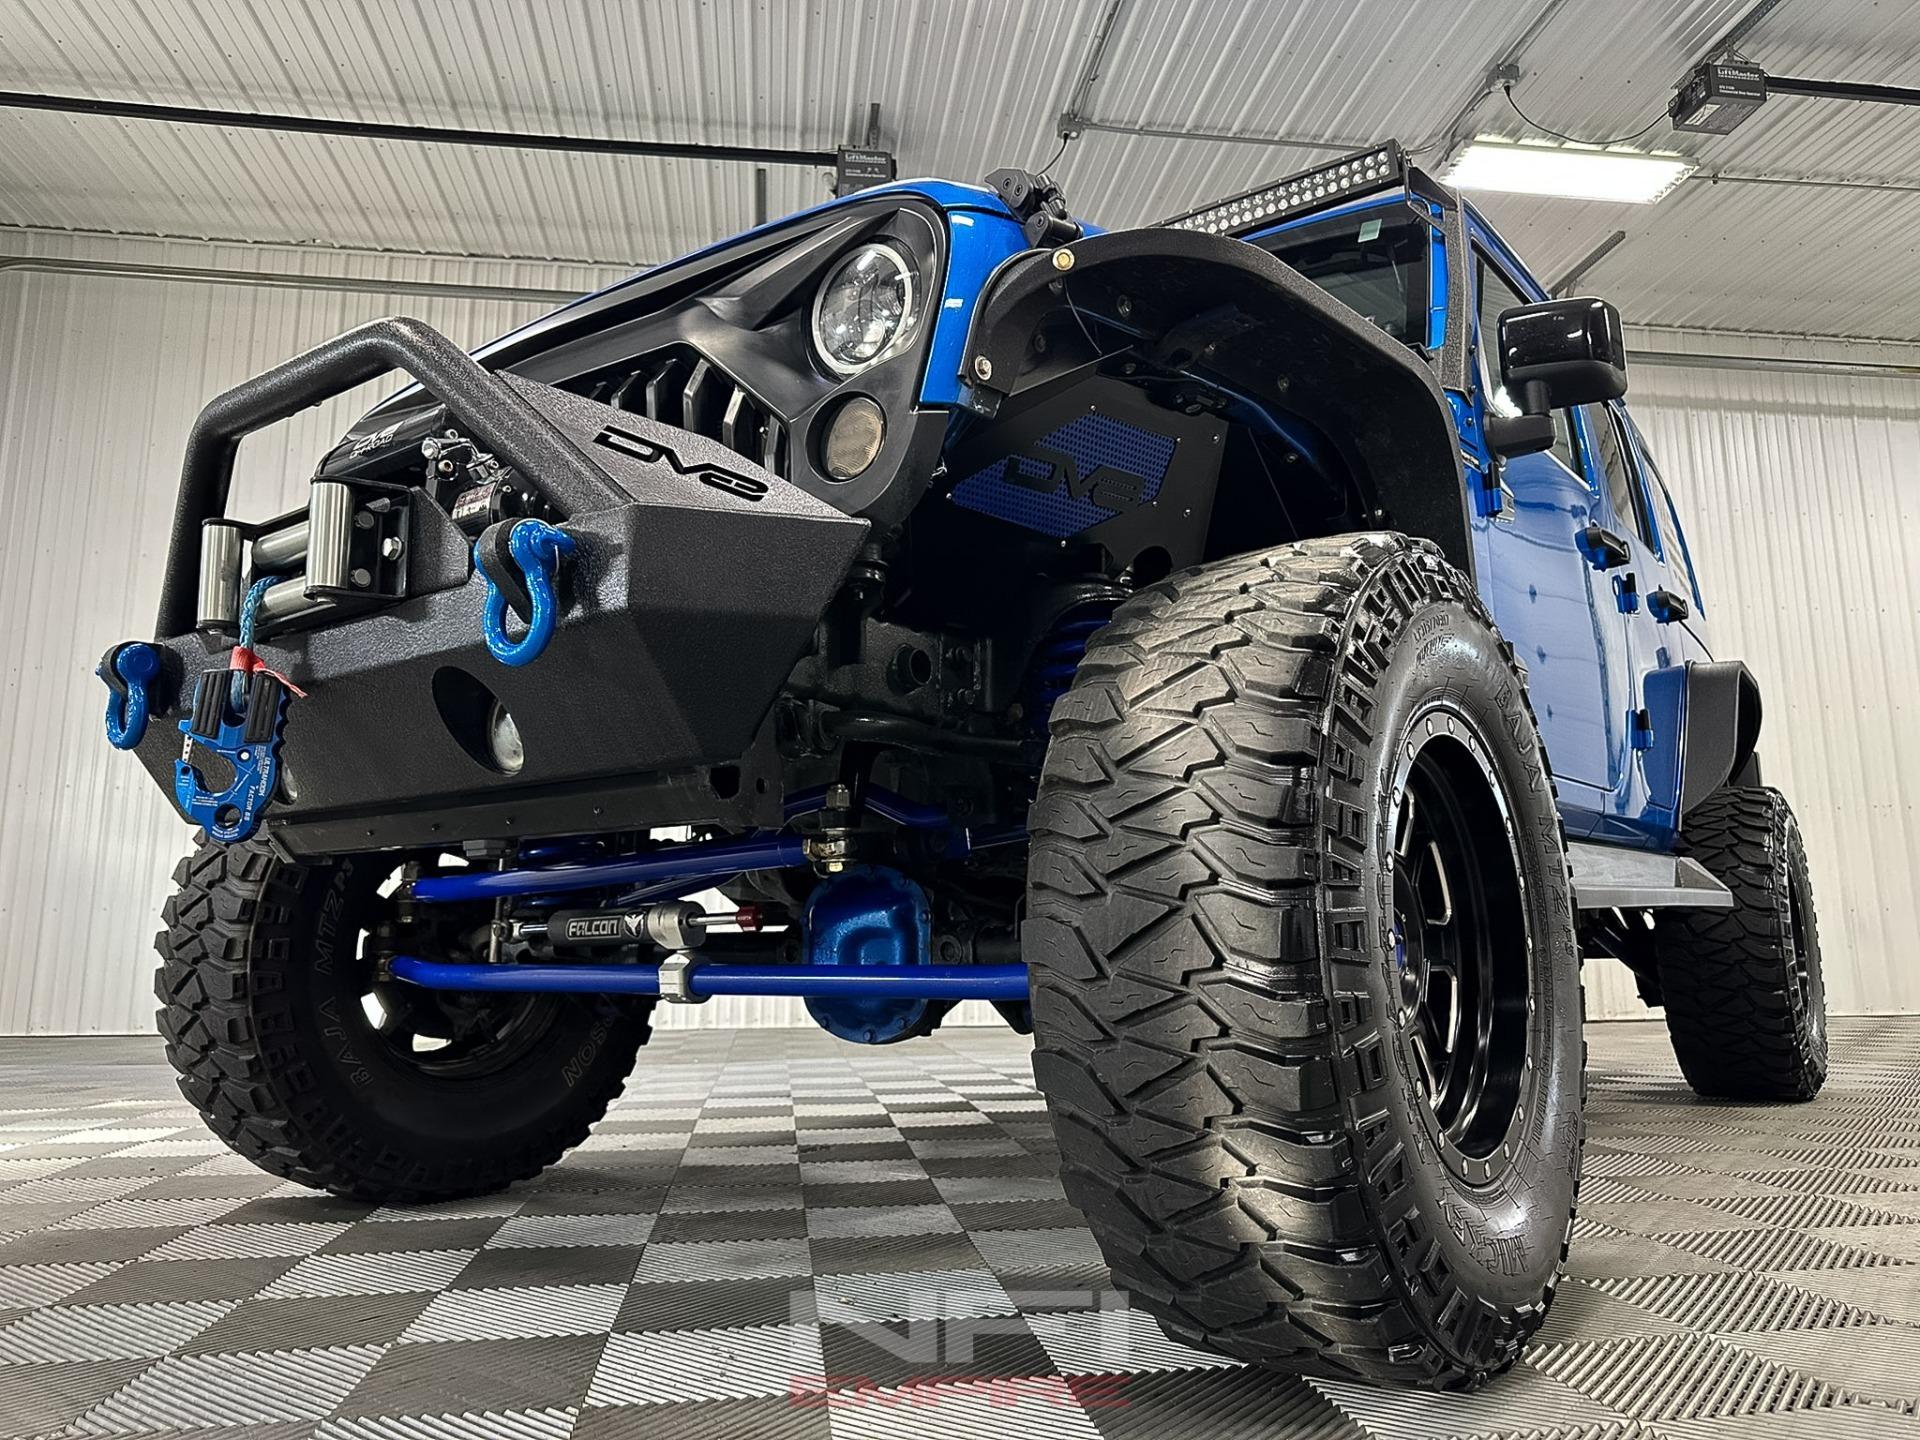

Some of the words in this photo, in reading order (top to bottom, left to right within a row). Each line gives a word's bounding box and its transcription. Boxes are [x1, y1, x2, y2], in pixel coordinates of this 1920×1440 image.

[593, 424, 769, 502] DV8
[1003, 450, 1145, 511] DV8
[1495, 680, 1543, 793] BAJA
[1538, 815, 1571, 919] MTZ
[314, 889, 344, 975] MTZ
[568, 921, 618, 937] FALCON
[318, 996, 374, 1088] BAJA
